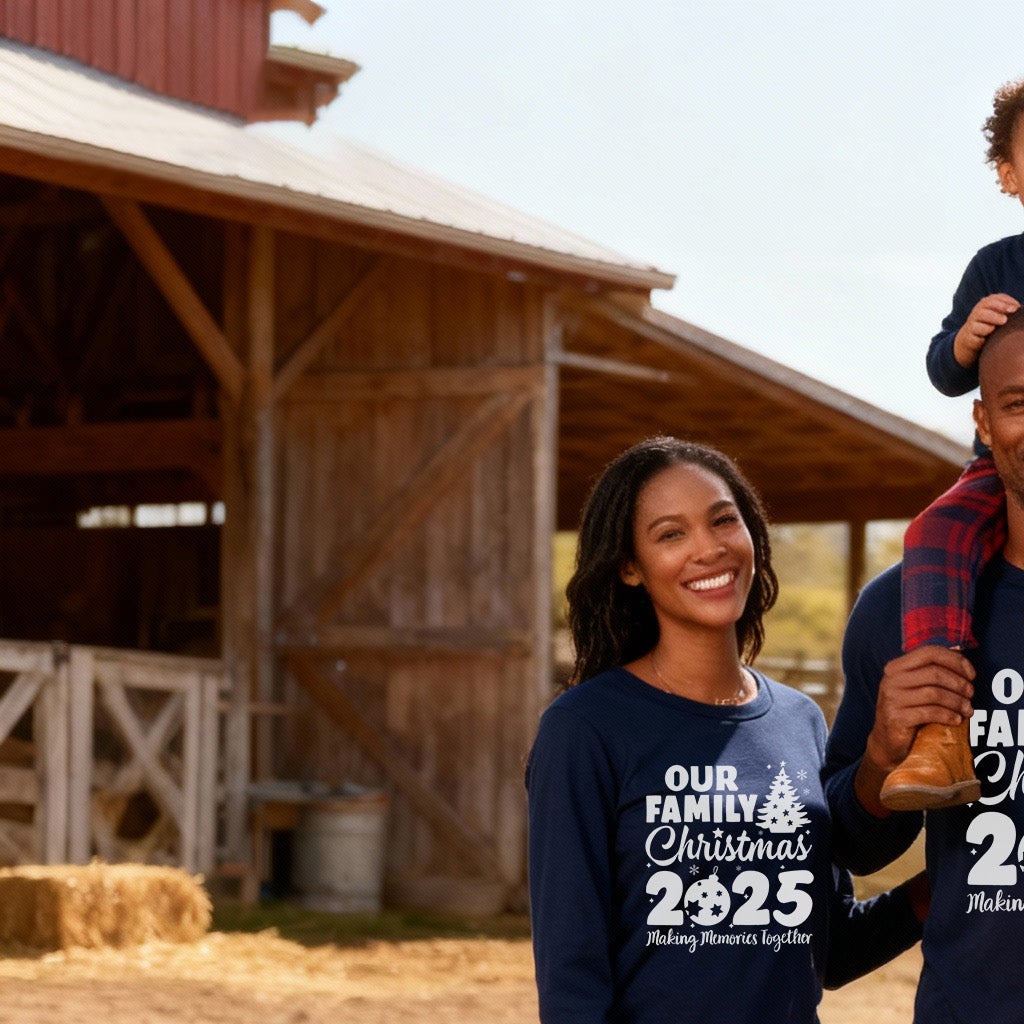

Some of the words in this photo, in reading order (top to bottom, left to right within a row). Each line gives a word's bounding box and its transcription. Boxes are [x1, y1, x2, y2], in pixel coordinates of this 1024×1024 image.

[665, 765, 738, 792] OUR
[646, 794, 757, 823] FAMILY
[645, 825, 812, 866] Christmas
[646, 870, 814, 927] 2025
[646, 928, 699, 953] Making
[700, 931, 757, 945] Memories
[761, 930, 813, 952] Together
